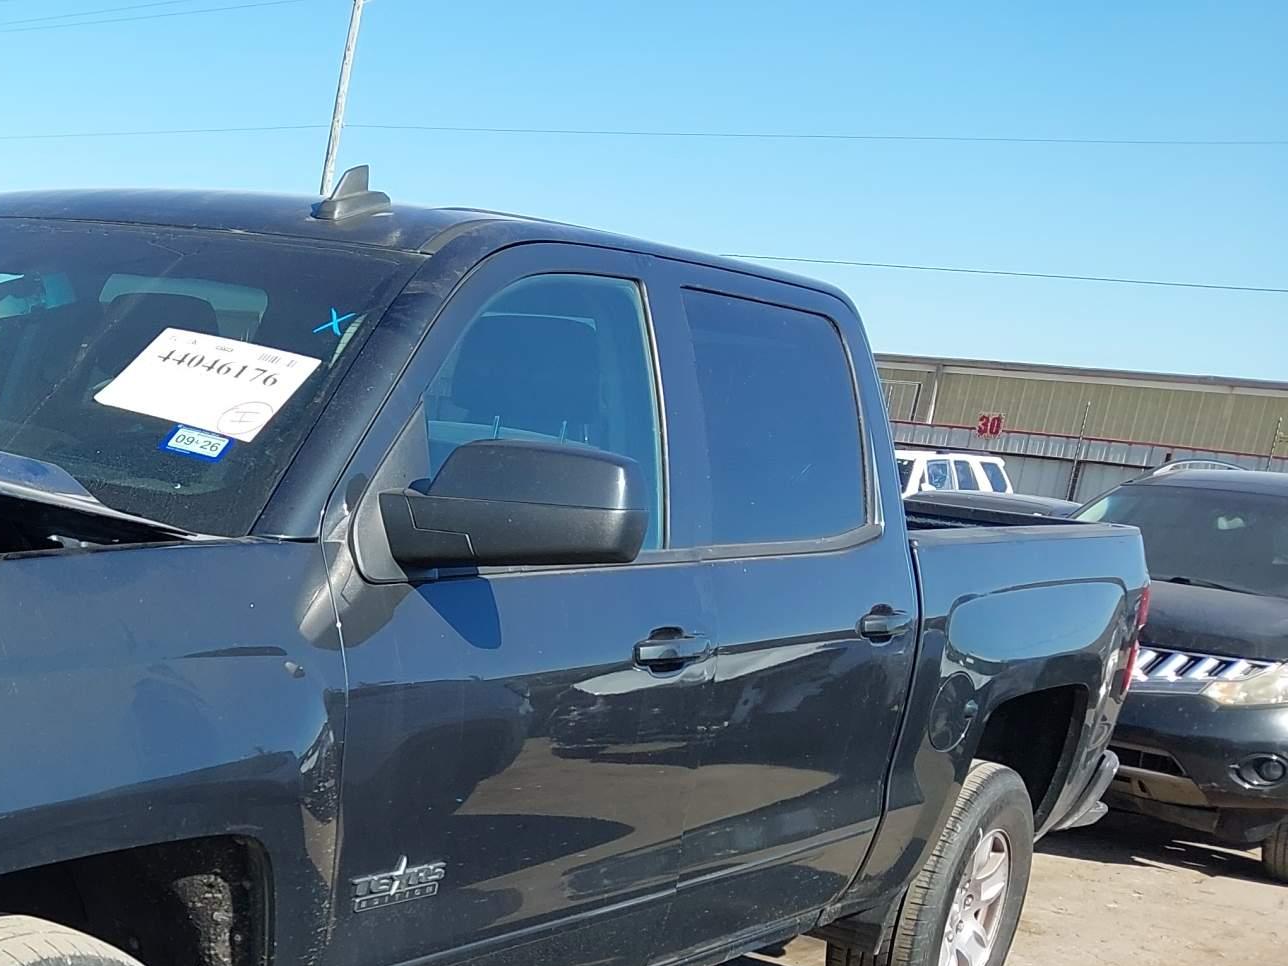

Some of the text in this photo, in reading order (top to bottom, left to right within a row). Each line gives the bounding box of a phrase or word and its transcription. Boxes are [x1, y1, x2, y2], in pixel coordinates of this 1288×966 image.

[157, 349, 280, 387] 44046176
[978, 415, 1002, 436] 30
[174, 433, 195, 446] 09
[200, 440, 221, 452] 26
